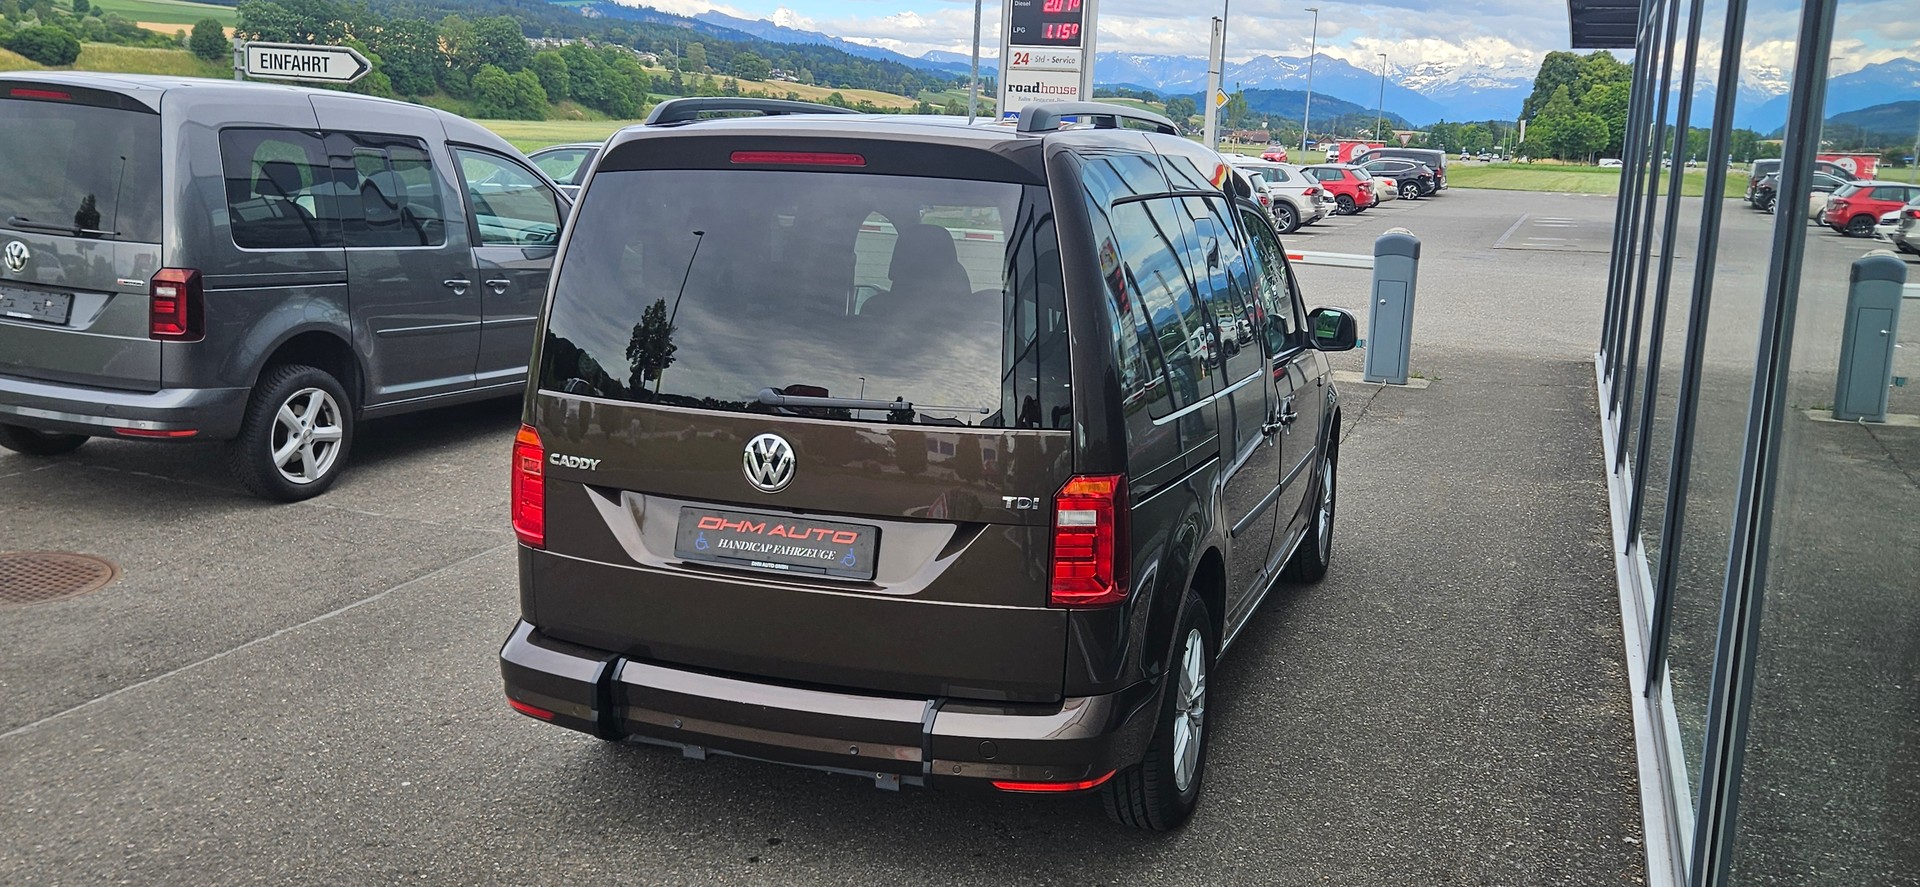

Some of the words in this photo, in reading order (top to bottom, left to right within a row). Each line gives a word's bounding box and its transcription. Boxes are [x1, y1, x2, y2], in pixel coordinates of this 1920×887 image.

[260, 52, 330, 73] EINFAHRT
[1051, 56, 1076, 64] Service
[1008, 81, 1077, 95] roadhouse
[549, 453, 601, 471] CADDY
[744, 433, 796, 490] VW
[1002, 495, 1040, 510] TDI
[767, 524, 858, 544] AUTO
[718, 539, 773, 553] HANDICAP
[772, 545, 837, 560] FAHRZEUGE
